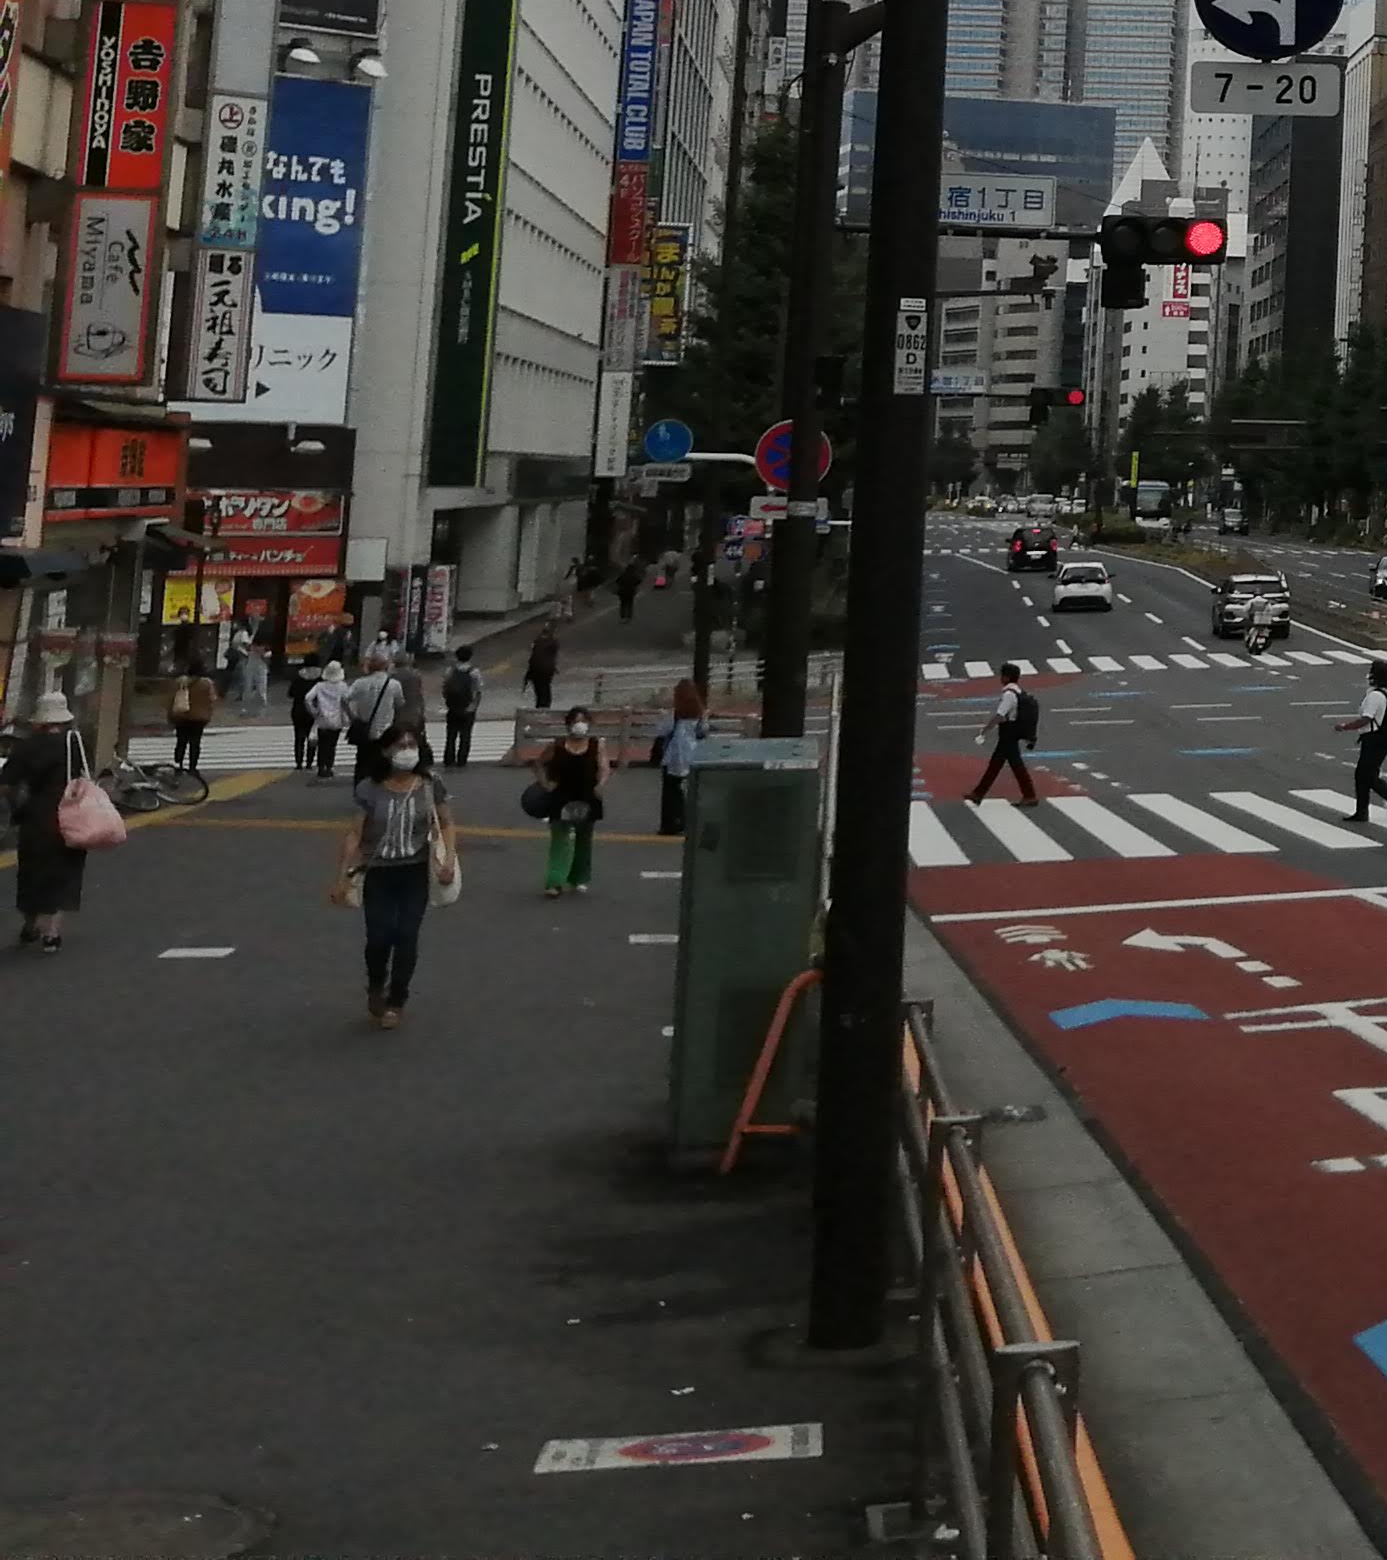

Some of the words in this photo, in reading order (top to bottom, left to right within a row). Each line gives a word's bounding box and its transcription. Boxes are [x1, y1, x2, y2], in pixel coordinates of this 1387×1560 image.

[91, 35, 119, 150] YOSHINOYA
[119, 37, 165, 154] 吉野家
[626, 46, 654, 99] TOTAL
[621, 98, 649, 153] CLUB
[264, 149, 346, 186] なんでも
[80, 215, 108, 306] Miyama
[906, 352, 918, 365] D
